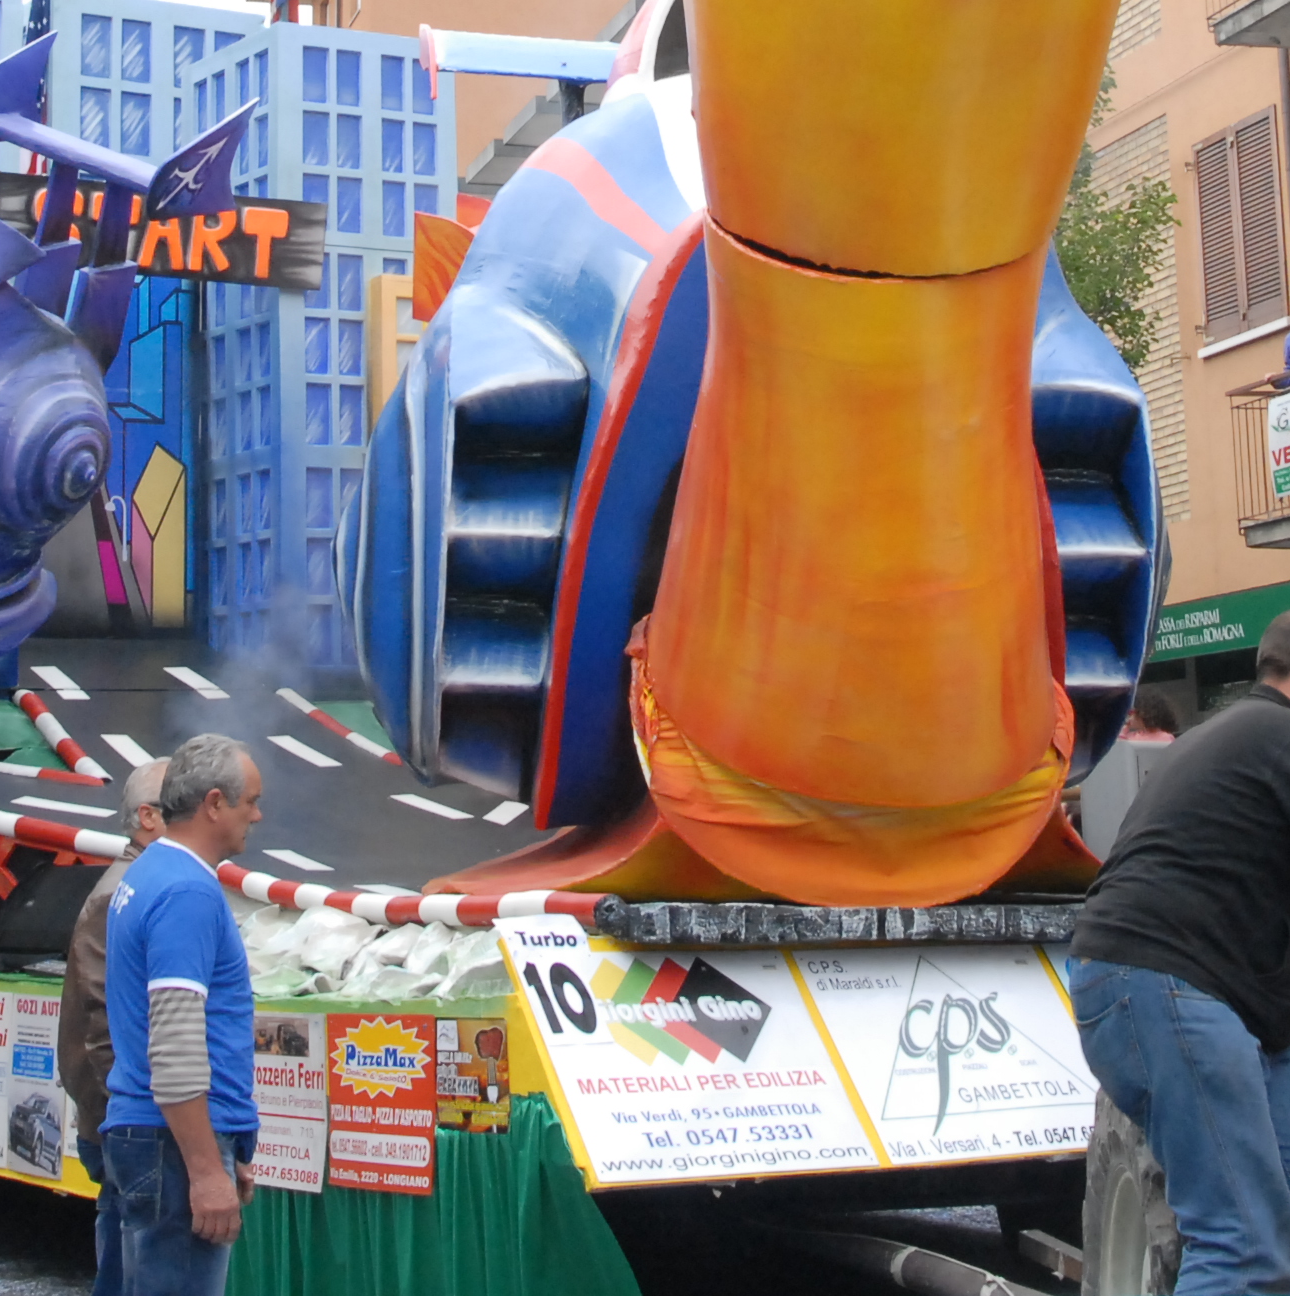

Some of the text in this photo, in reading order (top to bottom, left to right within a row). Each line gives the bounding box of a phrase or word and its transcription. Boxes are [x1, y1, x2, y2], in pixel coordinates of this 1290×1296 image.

[1184, 608, 1220, 629] RISPARMI
[1202, 622, 1245, 645] ROMAGNA
[514, 930, 578, 948] Turbo
[807, 960, 848, 975] C.P.S.
[815, 975, 902, 991] di Maraldi s.r.l.
[16, 998, 39, 1016] GOZI
[522, 961, 598, 1035] 10
[697, 994, 763, 1022] Gino
[345, 1043, 417, 1069] PizzaMax
[297, 1062, 325, 1091] Ferri
[576, 1068, 827, 1095] MATERIALI PER EDILIZIA
[260, 1091, 282, 1107] Bruno
[957, 1079, 1081, 1104] GAMBETTOLA
[352, 1105, 373, 1124] TAGLIO
[374, 1106, 394, 1125] PIZZA
[394, 1107, 433, 1128] D'ASPORTO
[611, 1110, 638, 1124] Via
[640, 1108, 688, 1124] Verdi,
[641, 1130, 681, 1149] Tel.
[887, 1140, 917, 1159] Via
[930, 1133, 991, 1154] Versari,
[991, 1134, 1002, 1148] 4
[1012, 1129, 1043, 1147] Tel.
[602, 1145, 868, 1172] www.giorginigino.com
[330, 1167, 339, 1179] Via
[338, 1168, 360, 1183] Emilia,
[383, 1173, 430, 1189] LONGIANO
